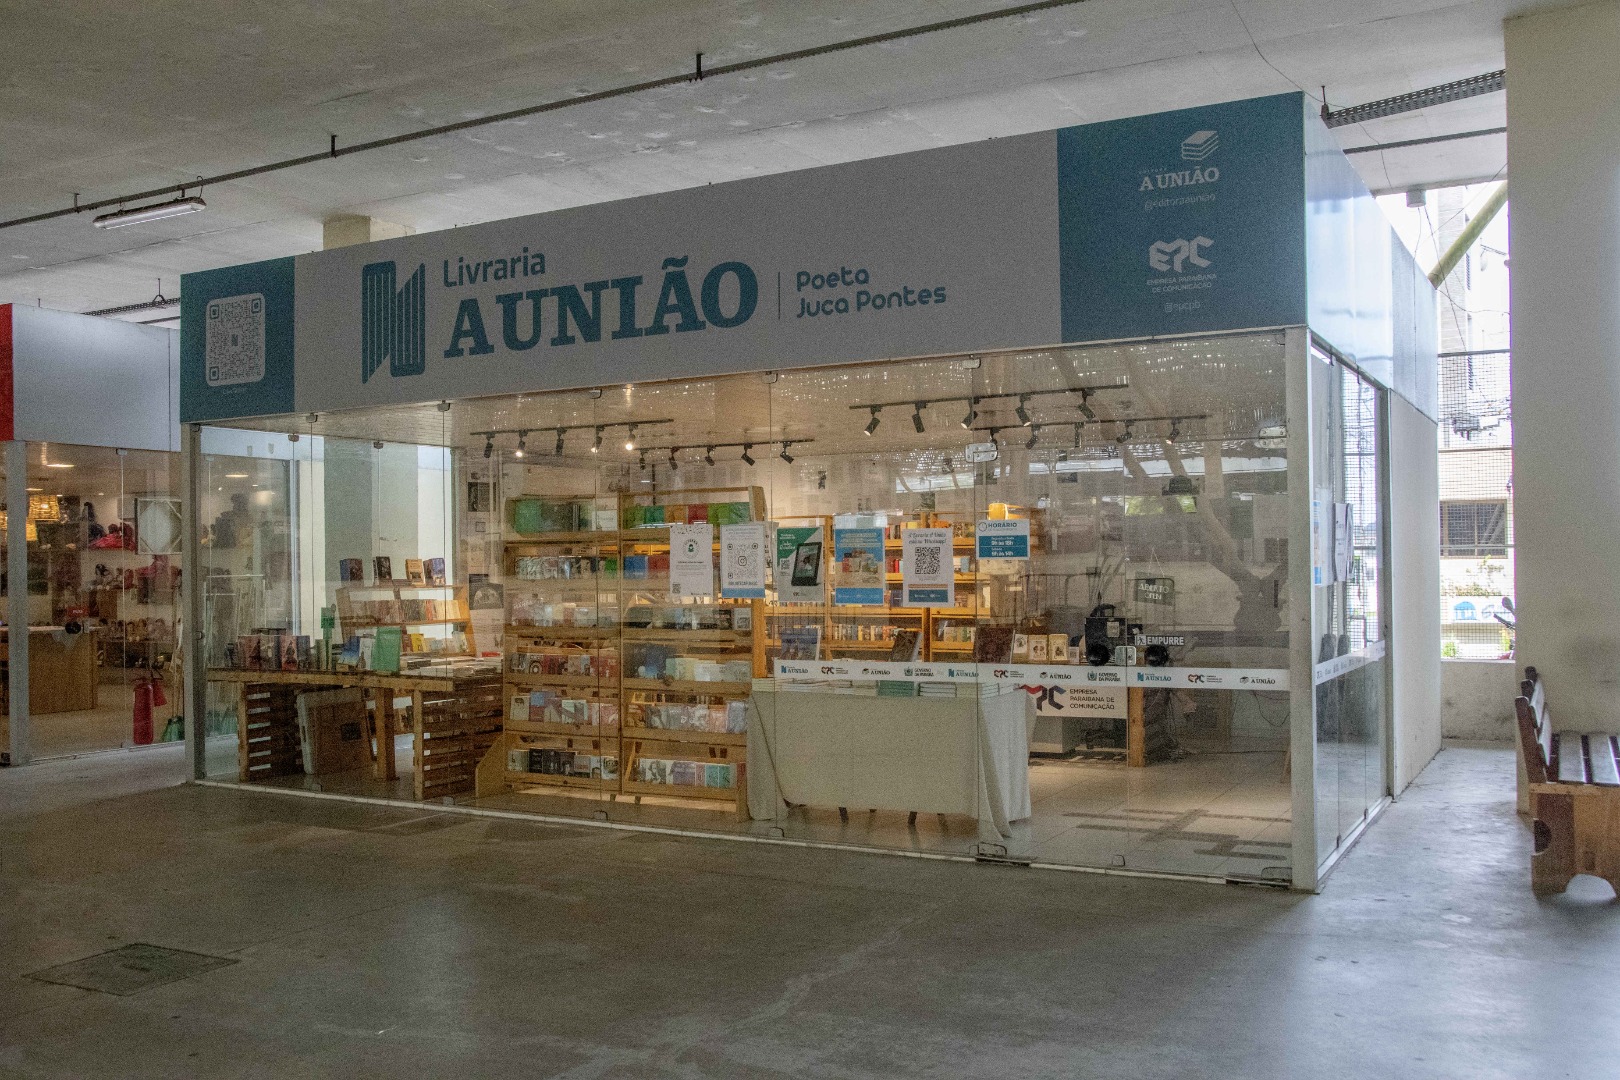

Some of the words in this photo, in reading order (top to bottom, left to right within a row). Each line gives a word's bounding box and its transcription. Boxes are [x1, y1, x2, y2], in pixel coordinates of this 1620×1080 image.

[1138, 176, 1155, 192] A
[1156, 166, 1220, 188] UNIÃO
[442, 247, 546, 288] Livraria
[796, 266, 870, 292] Poeta
[796, 298, 849, 318] Juca
[856, 286, 947, 312] Pontes
[1138, 583, 1170, 593] ABERTO
[1147, 636, 1185, 645] EMPURRE
[1069, 688, 1098, 696] EMPRESA
[1069, 695, 1104, 703] PARAIBANA
[1069, 702, 1115, 711] COMUNICAÇÃO
